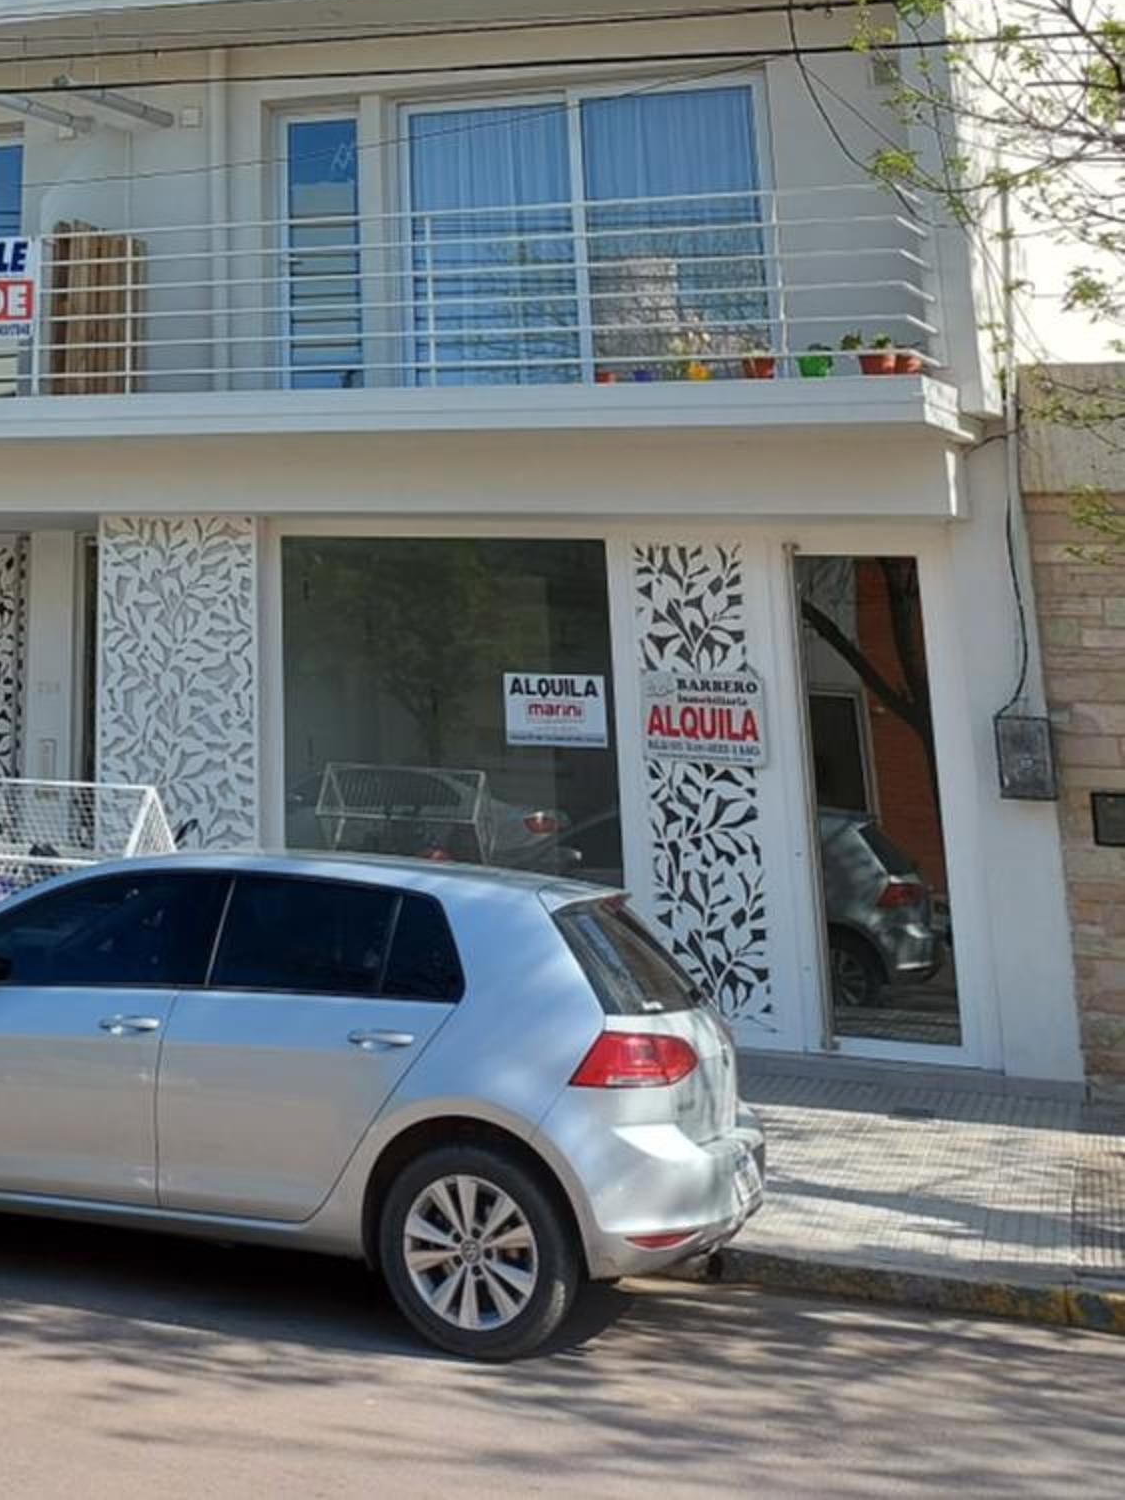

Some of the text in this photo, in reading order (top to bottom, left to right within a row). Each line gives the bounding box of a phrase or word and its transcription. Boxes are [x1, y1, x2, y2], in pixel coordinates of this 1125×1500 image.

[510, 677, 599, 698] ALQUILA
[677, 678, 757, 694] BARBERO
[648, 704, 758, 741] ALQUILA
